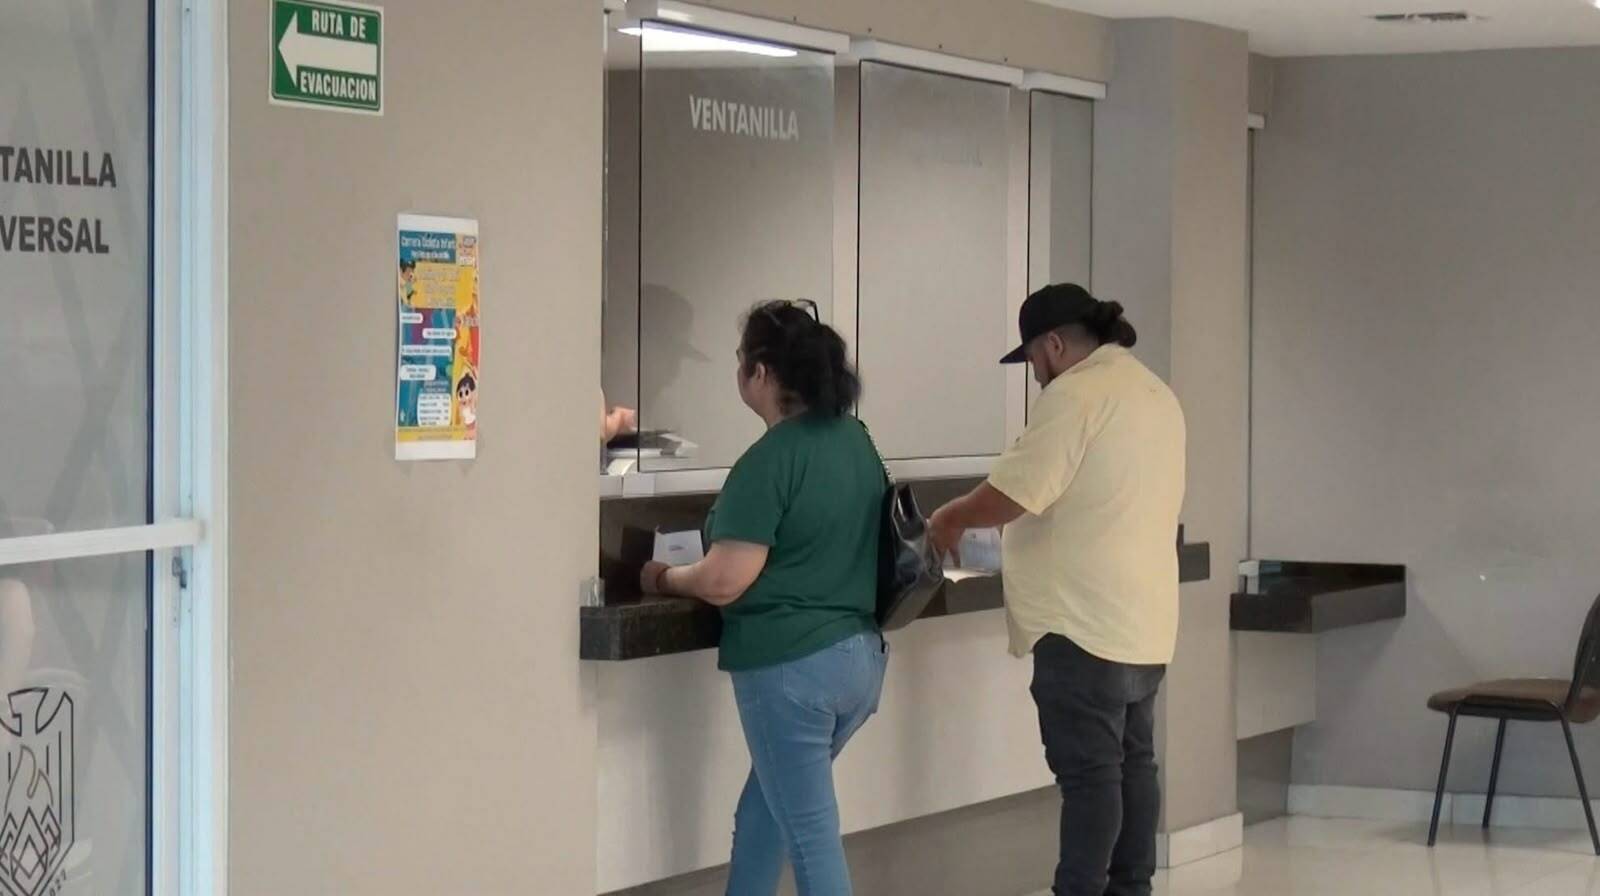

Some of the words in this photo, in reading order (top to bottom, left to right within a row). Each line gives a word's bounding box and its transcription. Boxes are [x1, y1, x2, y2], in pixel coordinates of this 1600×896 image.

[311, 9, 344, 36] RUTA
[350, 15, 367, 39] DE
[300, 71, 376, 102] EVACUACION
[689, 94, 800, 142] VENTANILLA
[0, 146, 117, 188] TANILLA
[0, 215, 110, 254] VERSAL
